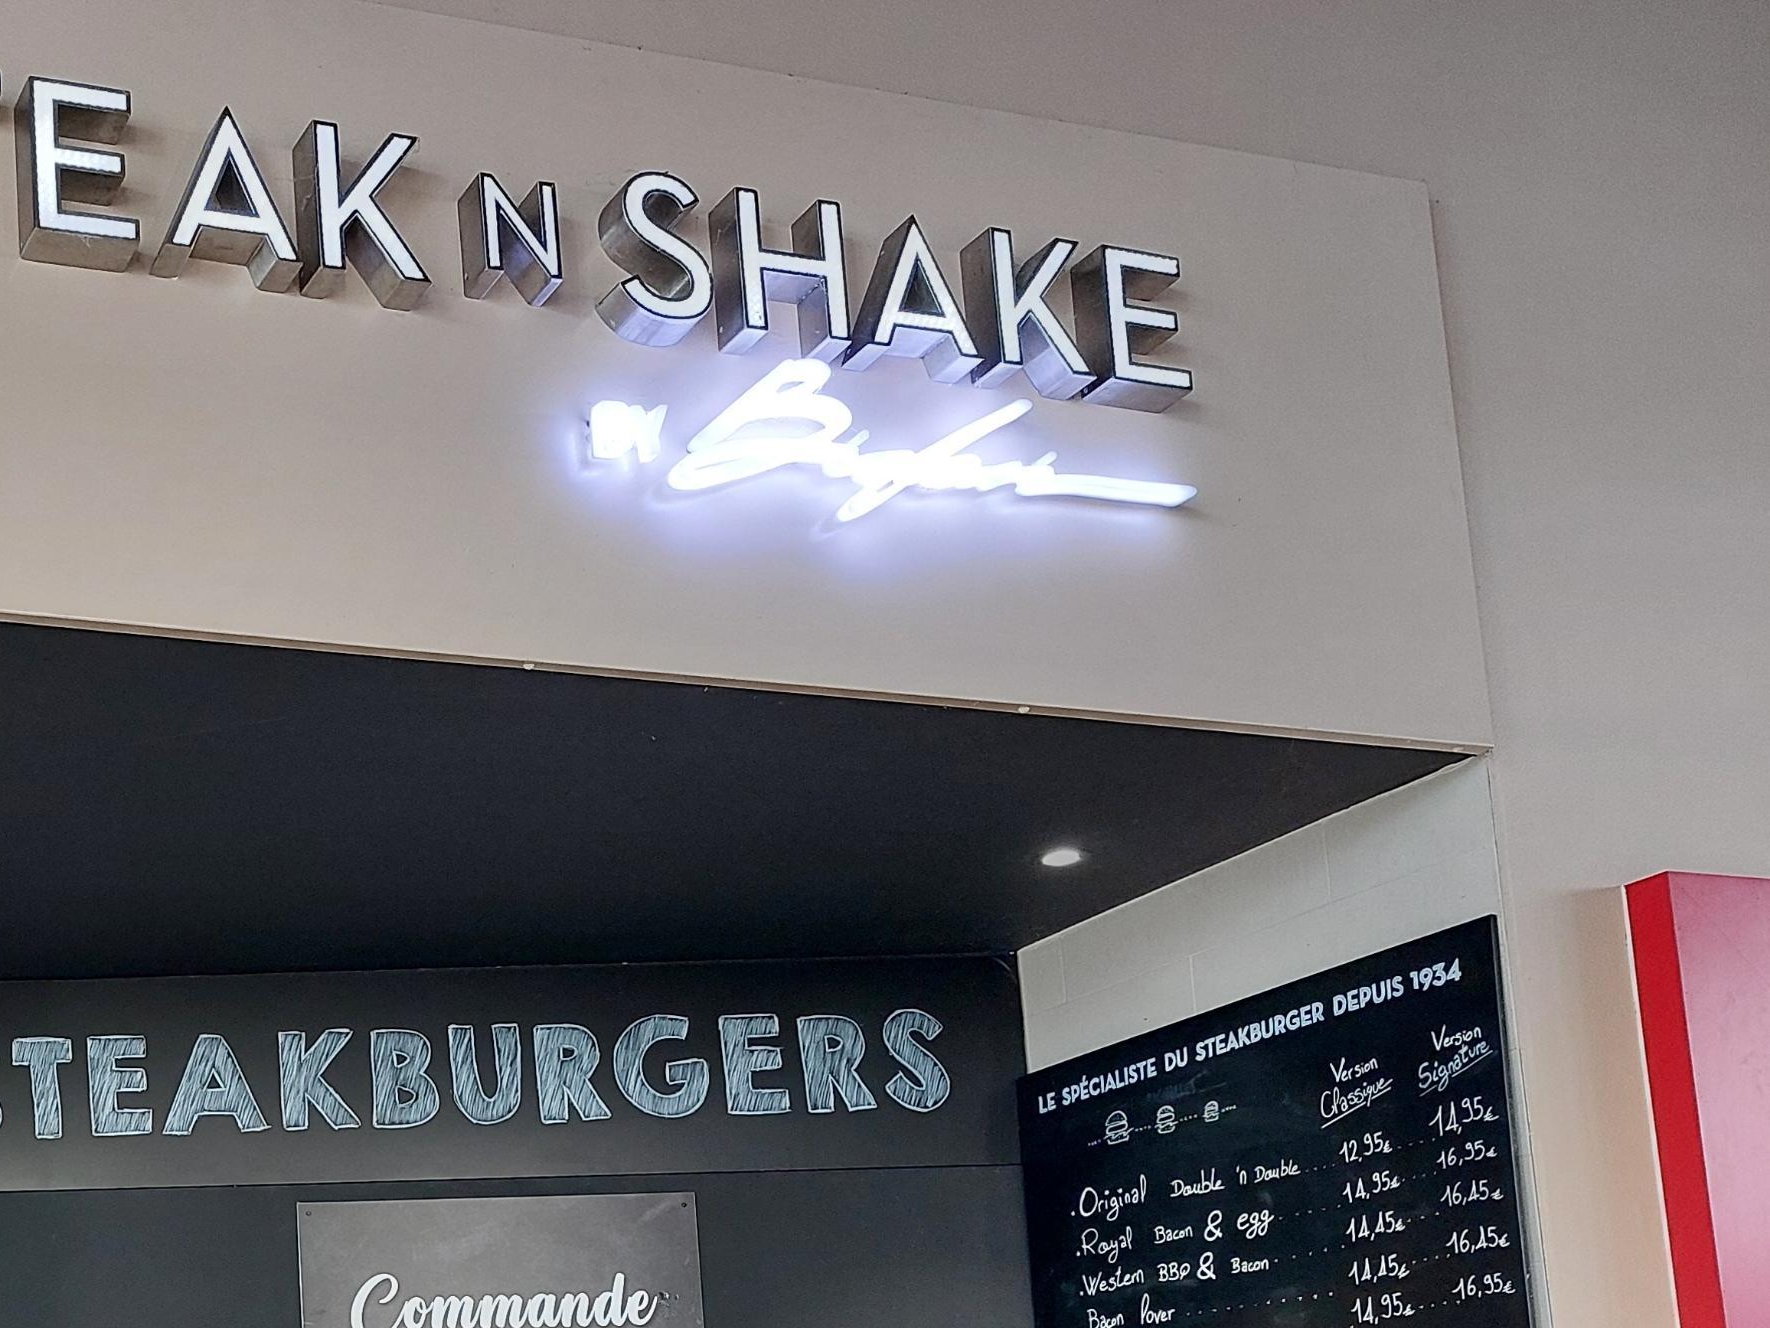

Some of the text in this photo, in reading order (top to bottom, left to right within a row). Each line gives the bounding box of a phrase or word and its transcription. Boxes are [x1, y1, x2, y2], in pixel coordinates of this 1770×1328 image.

[470, 173, 560, 292] N
[615, 172, 1194, 400] SHAKE
[1038, 957, 1462, 1114] LE SPÉCIALISTE DU STEAKBURGER DEPUIS 1934
[1431, 1026, 1483, 1051] Version
[1330, 1056, 1379, 1084] Version
[1418, 1041, 1490, 1091] Signature
[1320, 1077, 1392, 1119] Classique
[1079, 1174, 1147, 1221] Original
[1170, 1167, 1225, 1197] Double
[1253, 1159, 1301, 1183] Double
[1081, 1226, 1132, 1263] Royal
[1154, 1226, 1193, 1244] Bacon
[1204, 1210, 1223, 1241] &
[1237, 1209, 1274, 1239] egg
[1082, 1266, 1144, 1296] Western
[1156, 1263, 1191, 1281] BBQ
[1196, 1252, 1216, 1280] &
[1231, 1257, 1270, 1274] Bacon
